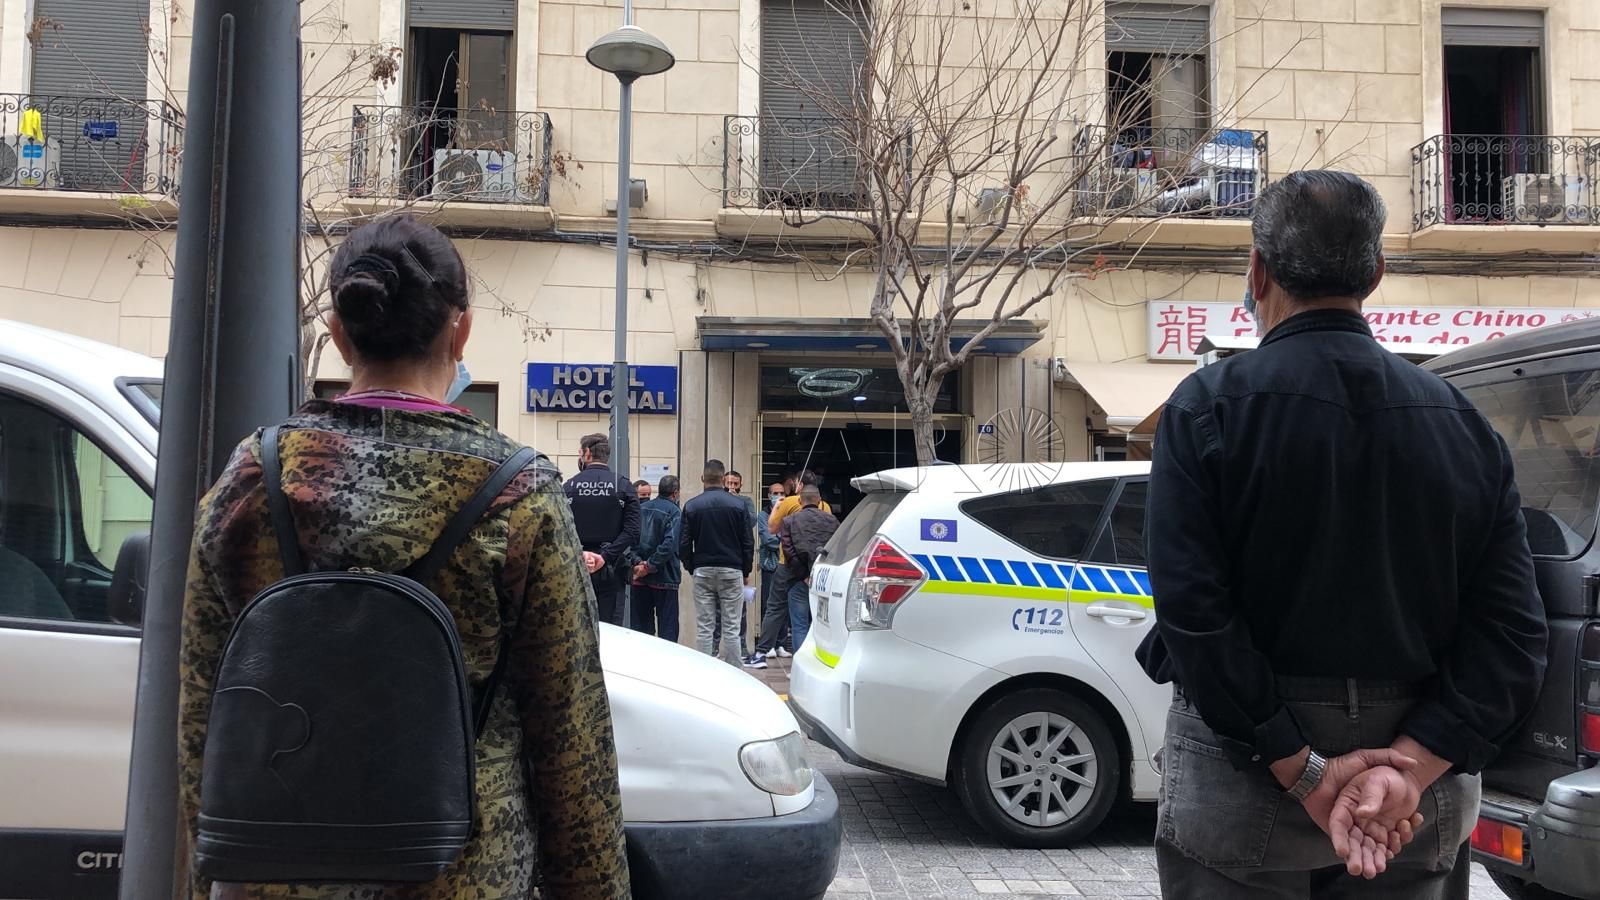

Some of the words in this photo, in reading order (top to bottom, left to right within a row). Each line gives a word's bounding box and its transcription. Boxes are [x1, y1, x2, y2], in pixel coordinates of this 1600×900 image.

[1451, 309, 1547, 327] Chino
[1156, 304, 1208, 355] 龍
[552, 366, 645, 387] HOTL
[576, 481, 614, 489] POLICIA
[1024, 607, 1064, 626] 112
[1533, 732, 1568, 750] GLX
[76, 850, 123, 869] CIT
